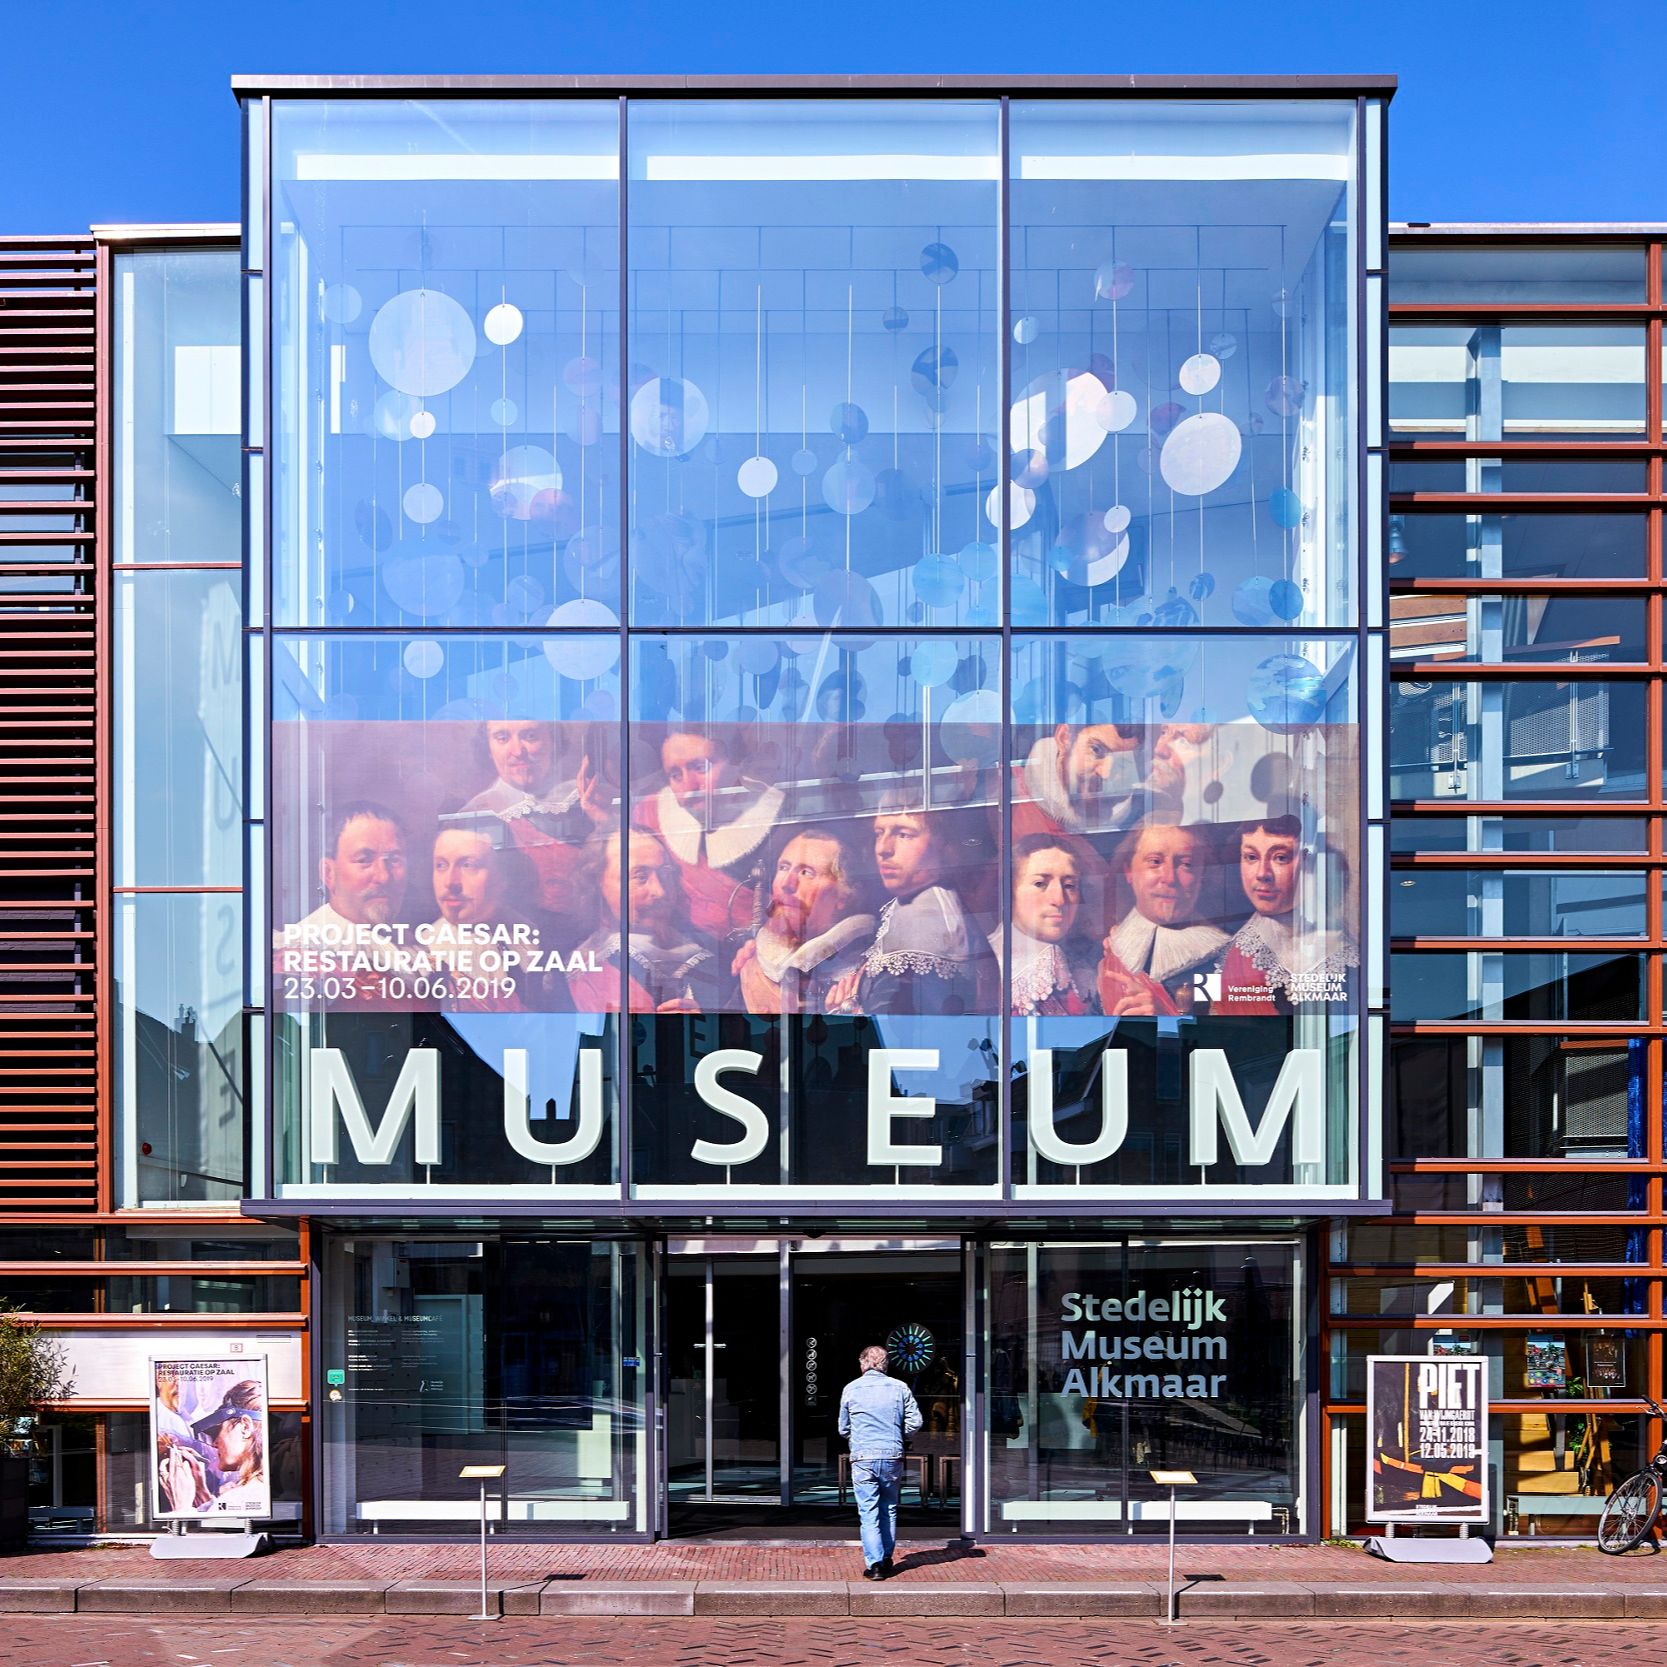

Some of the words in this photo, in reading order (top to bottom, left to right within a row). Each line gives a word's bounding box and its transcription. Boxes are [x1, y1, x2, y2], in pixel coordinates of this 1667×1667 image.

[284, 923, 409, 945] PROJECT
[415, 923, 540, 945] CAESAR:
[284, 950, 472, 972] RESTAURATIE
[479, 950, 520, 972] OP
[527, 950, 602, 972] ZAAL
[1228, 985, 1274, 994] Vereniging
[1228, 994, 1276, 1002] Rembrandt
[1290, 992, 1347, 1002] ALKMAAR
[1291, 983, 1342, 992] MUSEUM
[310, 1047, 1321, 1166] MUSEUM
[1061, 1287, 1227, 1330] Stedelijk
[1061, 1330, 1227, 1360] Museum
[1060, 1366, 1227, 1398] Alkmaar
[1418, 1363, 1480, 1409] PIET
[1419, 1427, 1476, 1443] 24.11.2018
[1420, 1443, 1476, 1459] 12.05.2019
